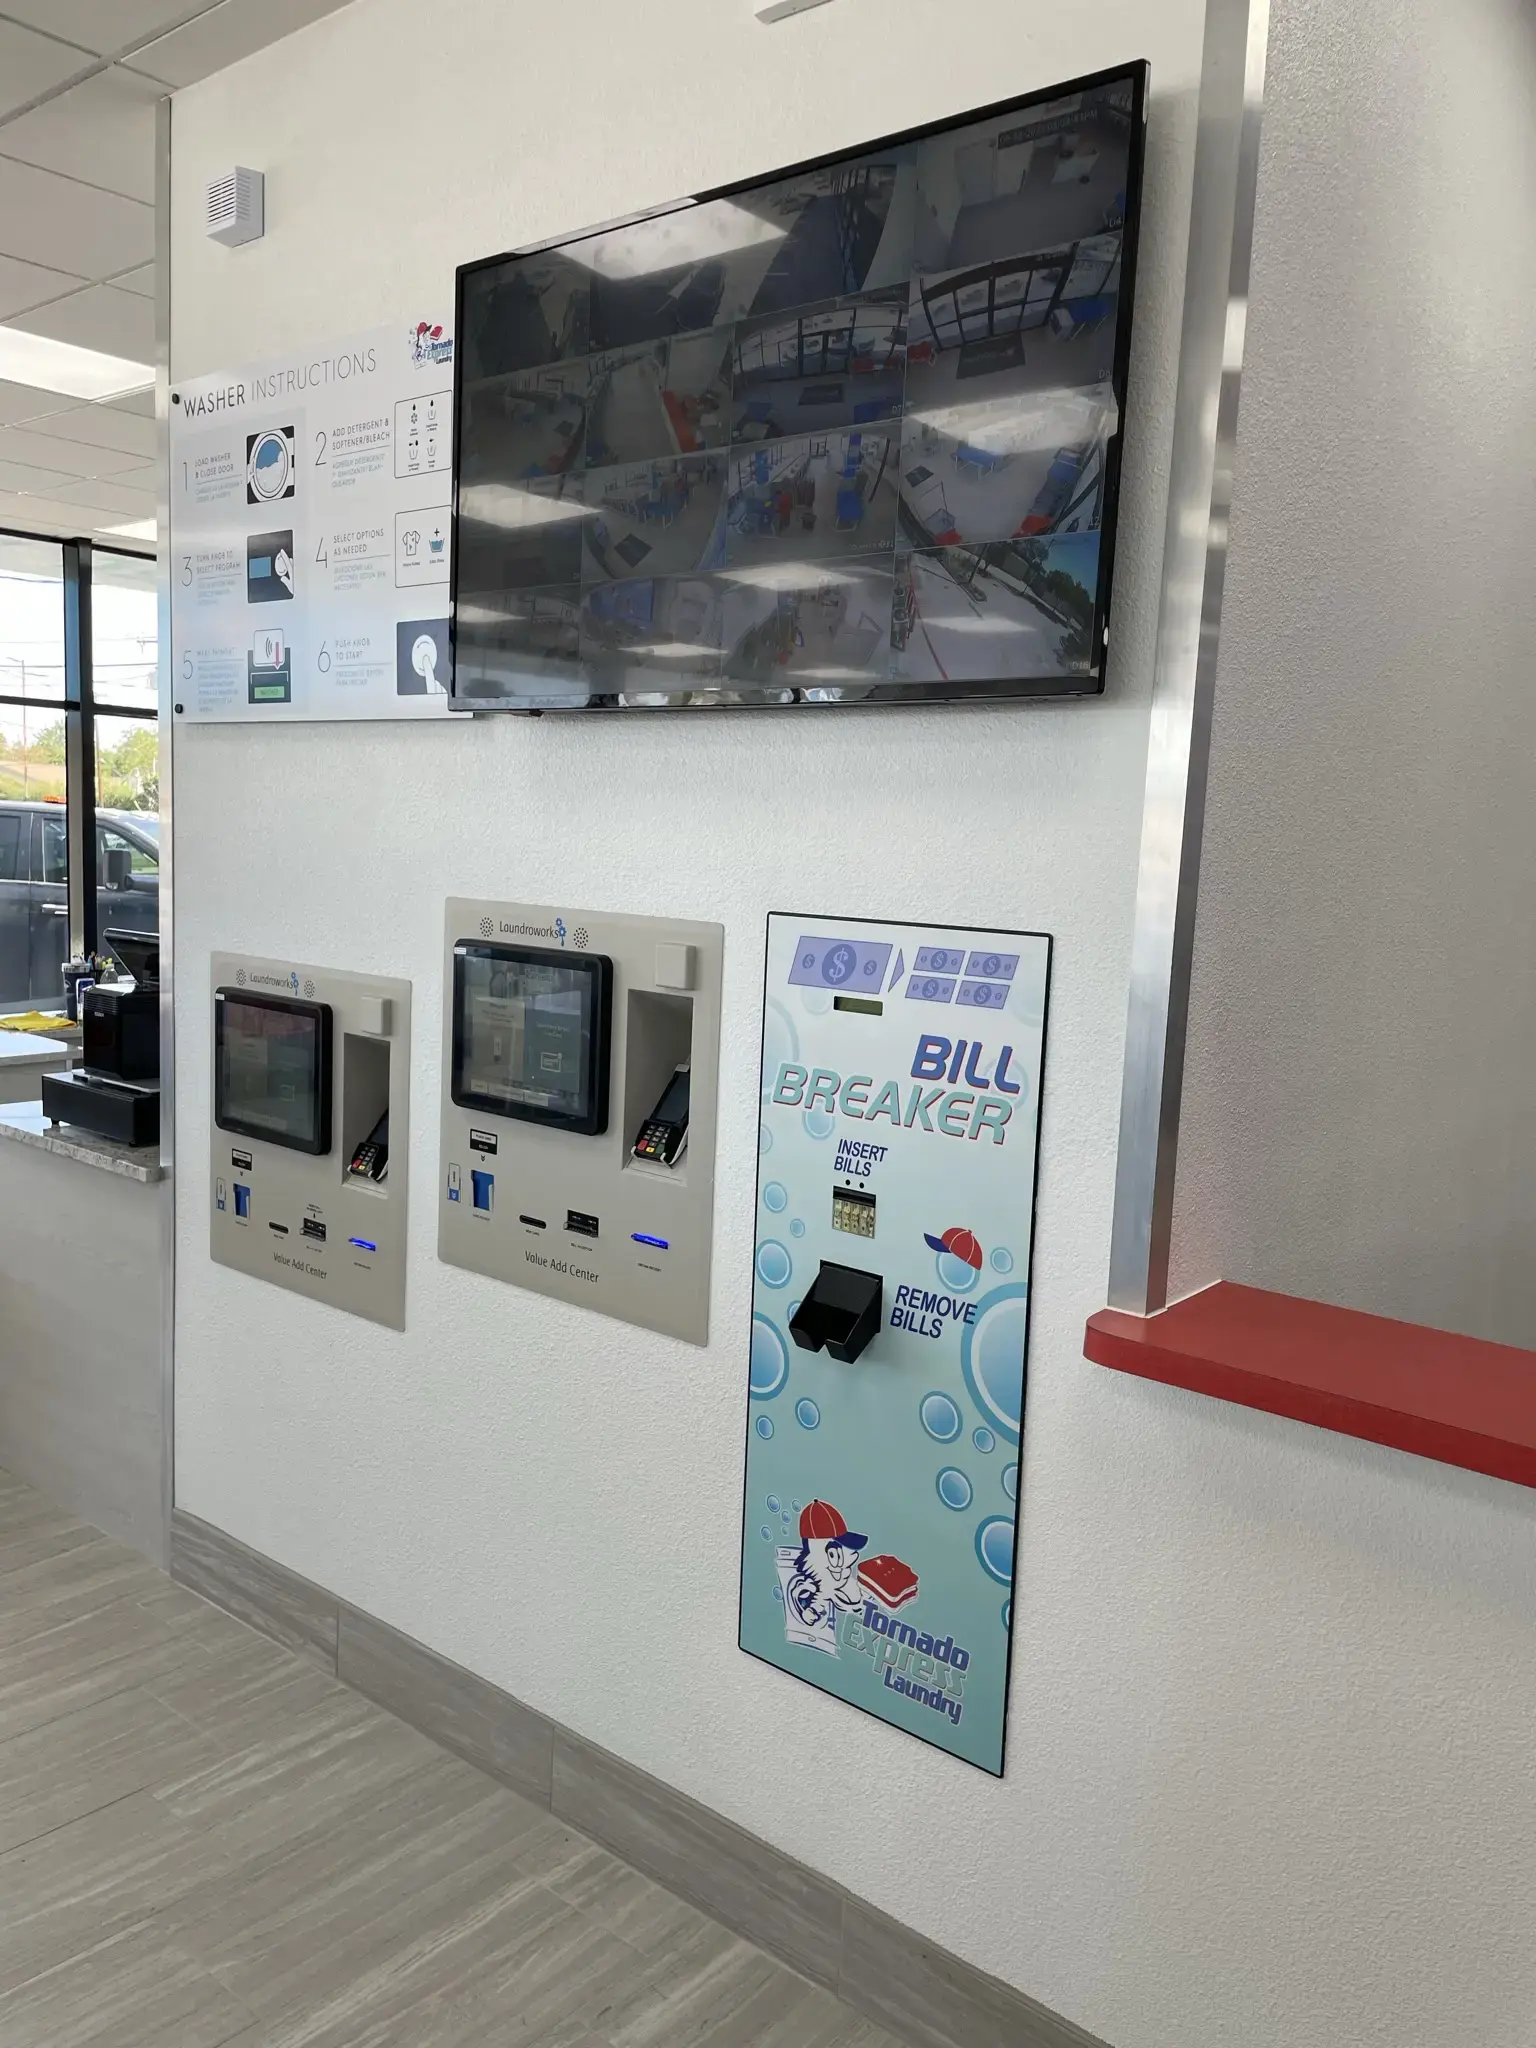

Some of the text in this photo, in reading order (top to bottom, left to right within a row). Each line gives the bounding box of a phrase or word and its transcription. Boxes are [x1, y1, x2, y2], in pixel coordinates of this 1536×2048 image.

[184, 348, 376, 418] WASHER INSTRUCTIONS
[332, 427, 346, 437] ADD
[347, 419, 383, 434] DETERGENT
[332, 431, 390, 450] SOFTENER/BLEACH
[315, 431, 327, 465] 2
[200, 468, 216, 478] CLOSE
[218, 464, 234, 475] DOOR
[333, 528, 384, 543] SELECT OPTIONS
[343, 544, 368, 554] NEEDED
[315, 537, 328, 568] 4
[181, 556, 193, 587] 3
[196, 562, 241, 574] SELECT PROGRAM
[317, 640, 331, 672] 6
[335, 638, 370, 648] PUSH KNOB
[336, 650, 363, 660] TO START
[182, 650, 194, 679] 5
[499, 920, 559, 939] Laundroworks
[250, 973, 293, 989] Laundroworks
[910, 1034, 1021, 1093] BILL
[772, 1063, 1014, 1145] BREAKER
[837, 1139, 888, 1163] INSERT
[834, 1156, 872, 1177] BILLS
[273, 1252, 327, 1279] Value Add Center
[525, 1251, 599, 1283] Value Add Center
[895, 1285, 978, 1325] REMOVE
[890, 1307, 943, 1339] BILLS
[862, 1600, 970, 1671] Tornado
[842, 1620, 967, 1696] Express
[884, 1667, 962, 1725] Laundry
